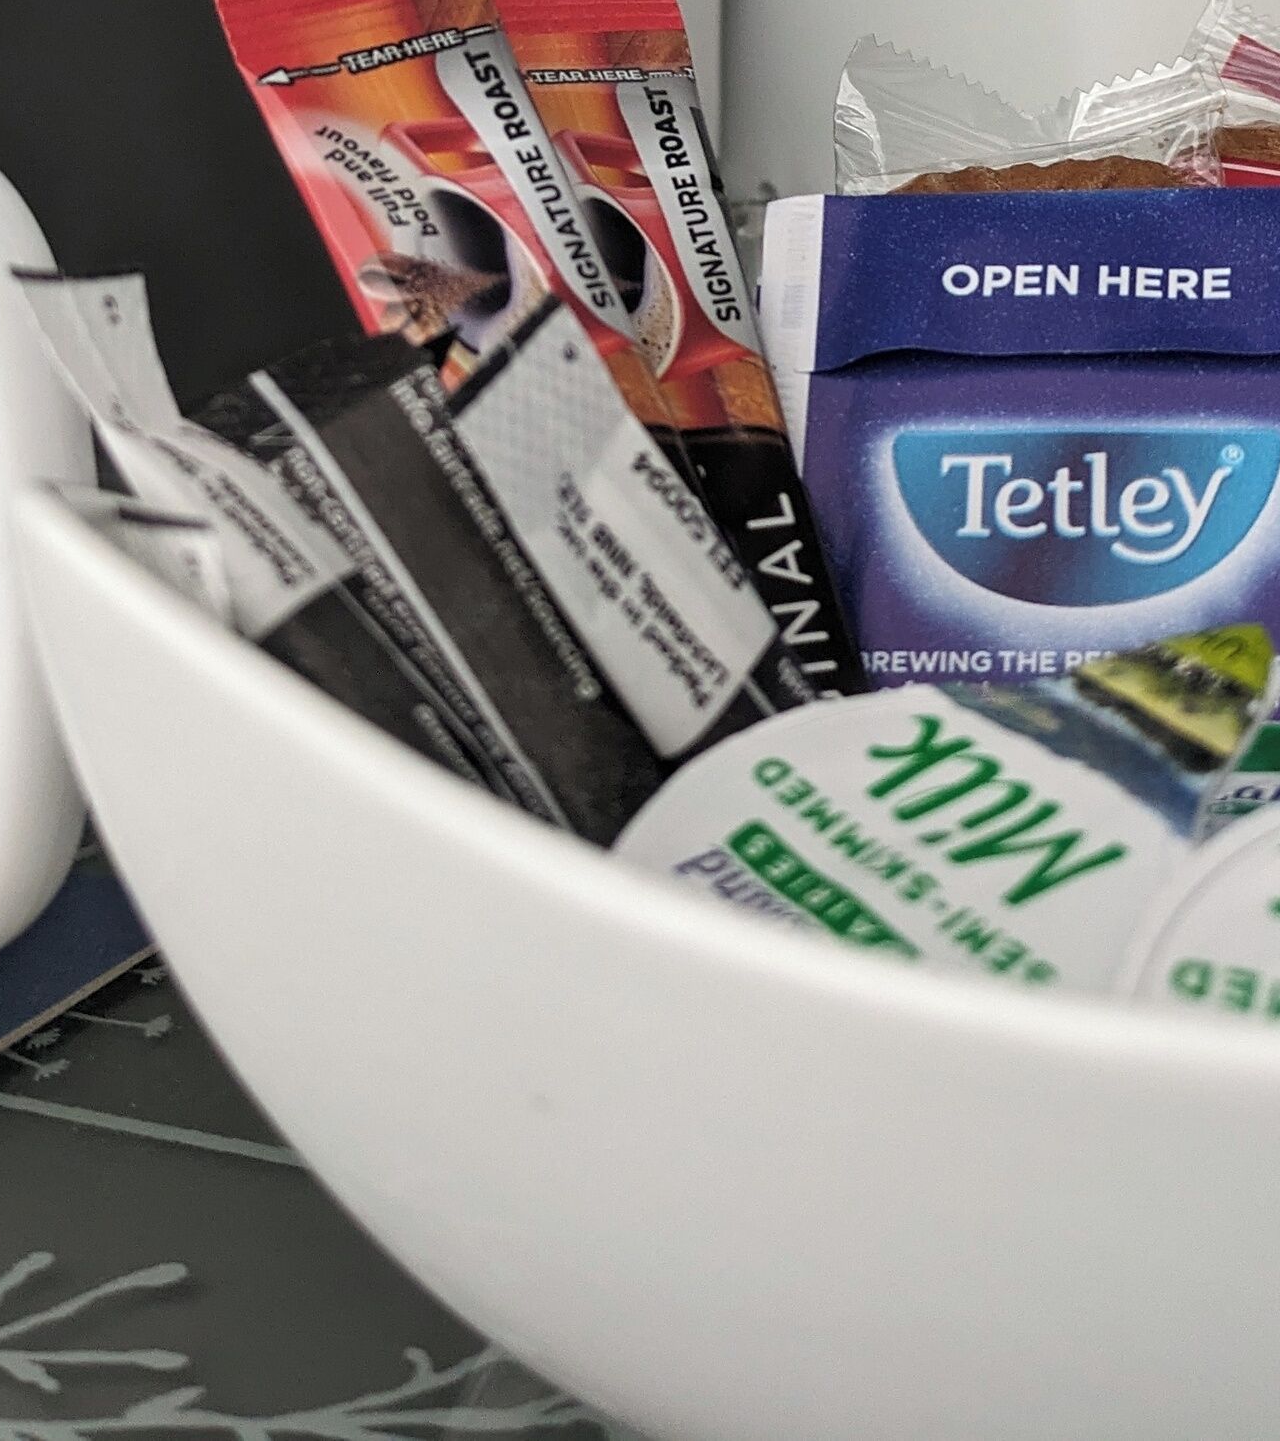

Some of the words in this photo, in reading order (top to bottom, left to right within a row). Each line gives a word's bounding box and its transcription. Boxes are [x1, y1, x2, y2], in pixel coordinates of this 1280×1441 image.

[341, 40, 403, 73] TEAR
[401, 27, 462, 59] HERE
[531, 69, 582, 84] TEAR
[588, 67, 645, 83] HERE
[463, 49, 537, 144] ROAST
[314, 125, 399, 183] flavour
[648, 85, 691, 170] ROAST
[323, 148, 373, 181] and
[367, 186, 412, 227] Full
[393, 187, 439, 236] bold
[516, 149, 615, 310] SIGNATURE
[671, 172, 741, 323] SIGNATURE
[941, 262, 1080, 298] OPEN
[1097, 262, 1233, 300] HERE
[939, 451, 1234, 565] Tetley
[746, 491, 843, 699] INAL
[996, 649, 1059, 674] THE
[867, 713, 1128, 909] Milk
